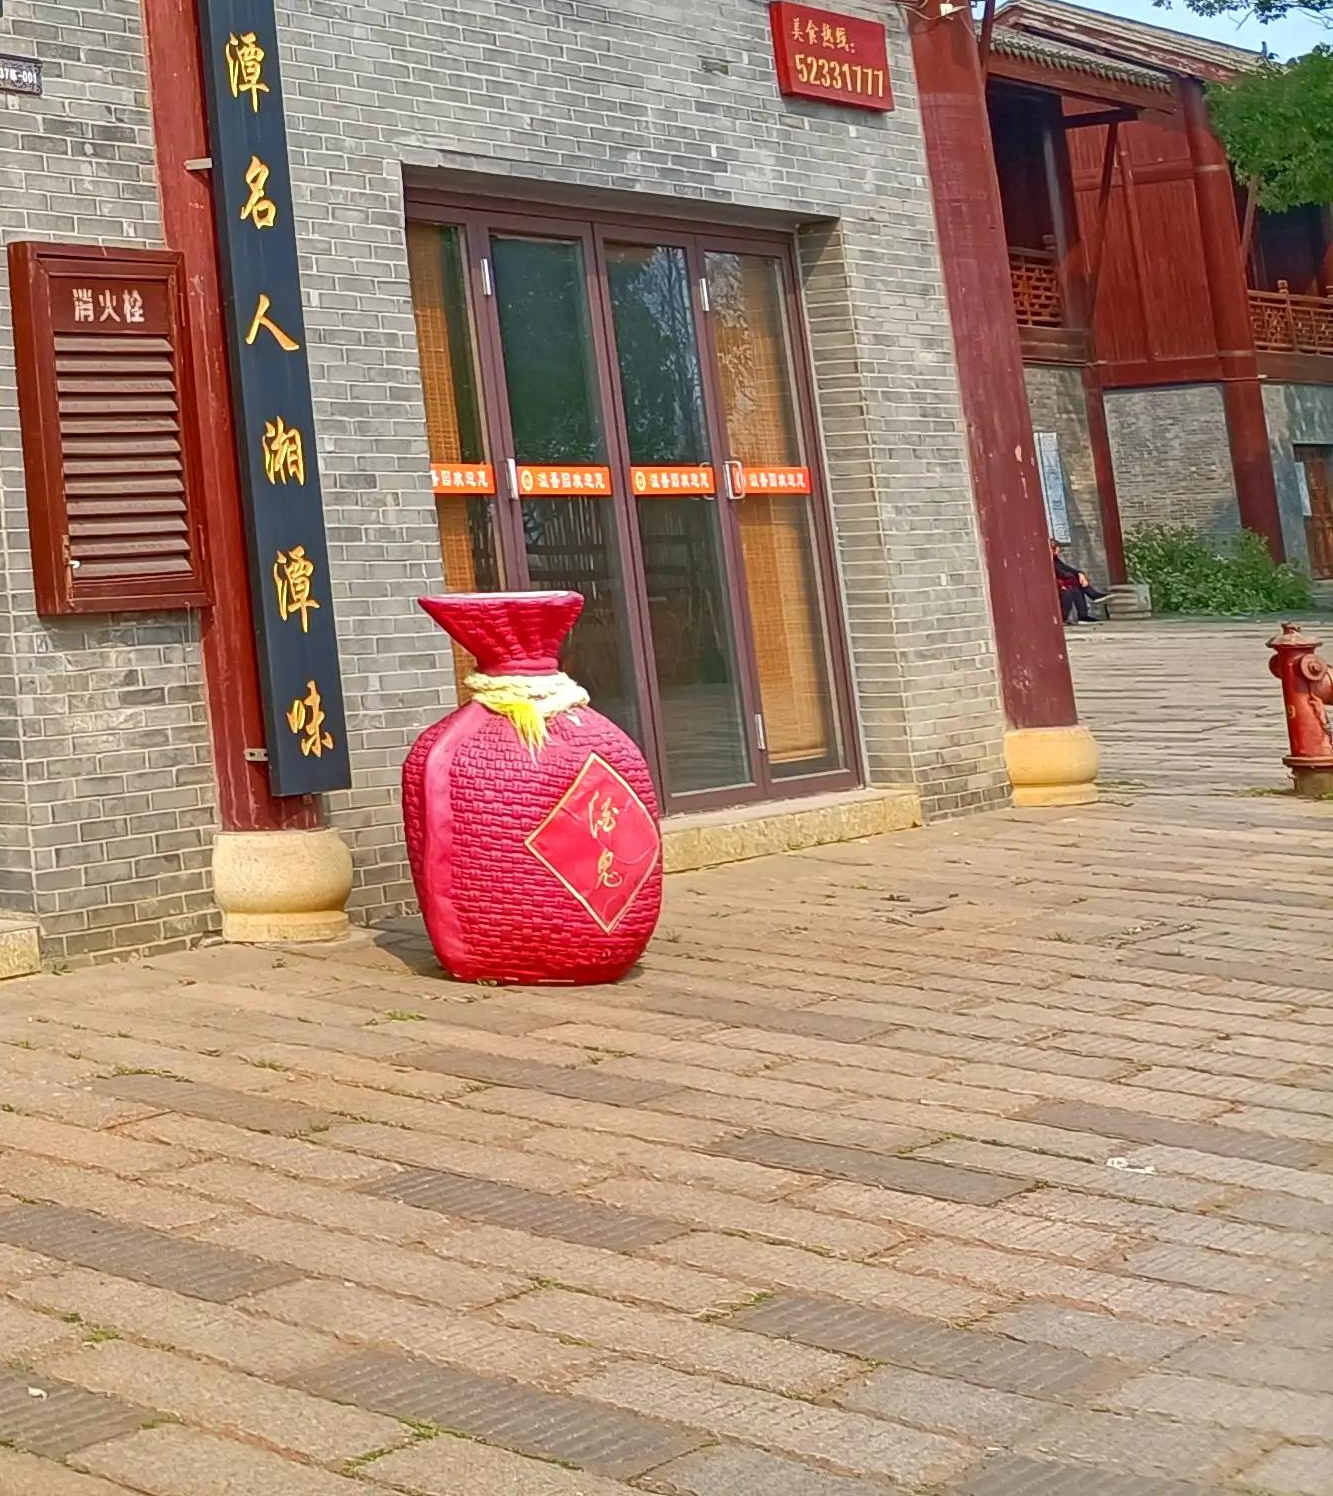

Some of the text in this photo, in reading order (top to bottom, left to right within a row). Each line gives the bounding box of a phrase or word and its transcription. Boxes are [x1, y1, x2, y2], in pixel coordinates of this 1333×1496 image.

[794, 53, 884, 98] 52331777
[72, 288, 145, 324] 消火栓
